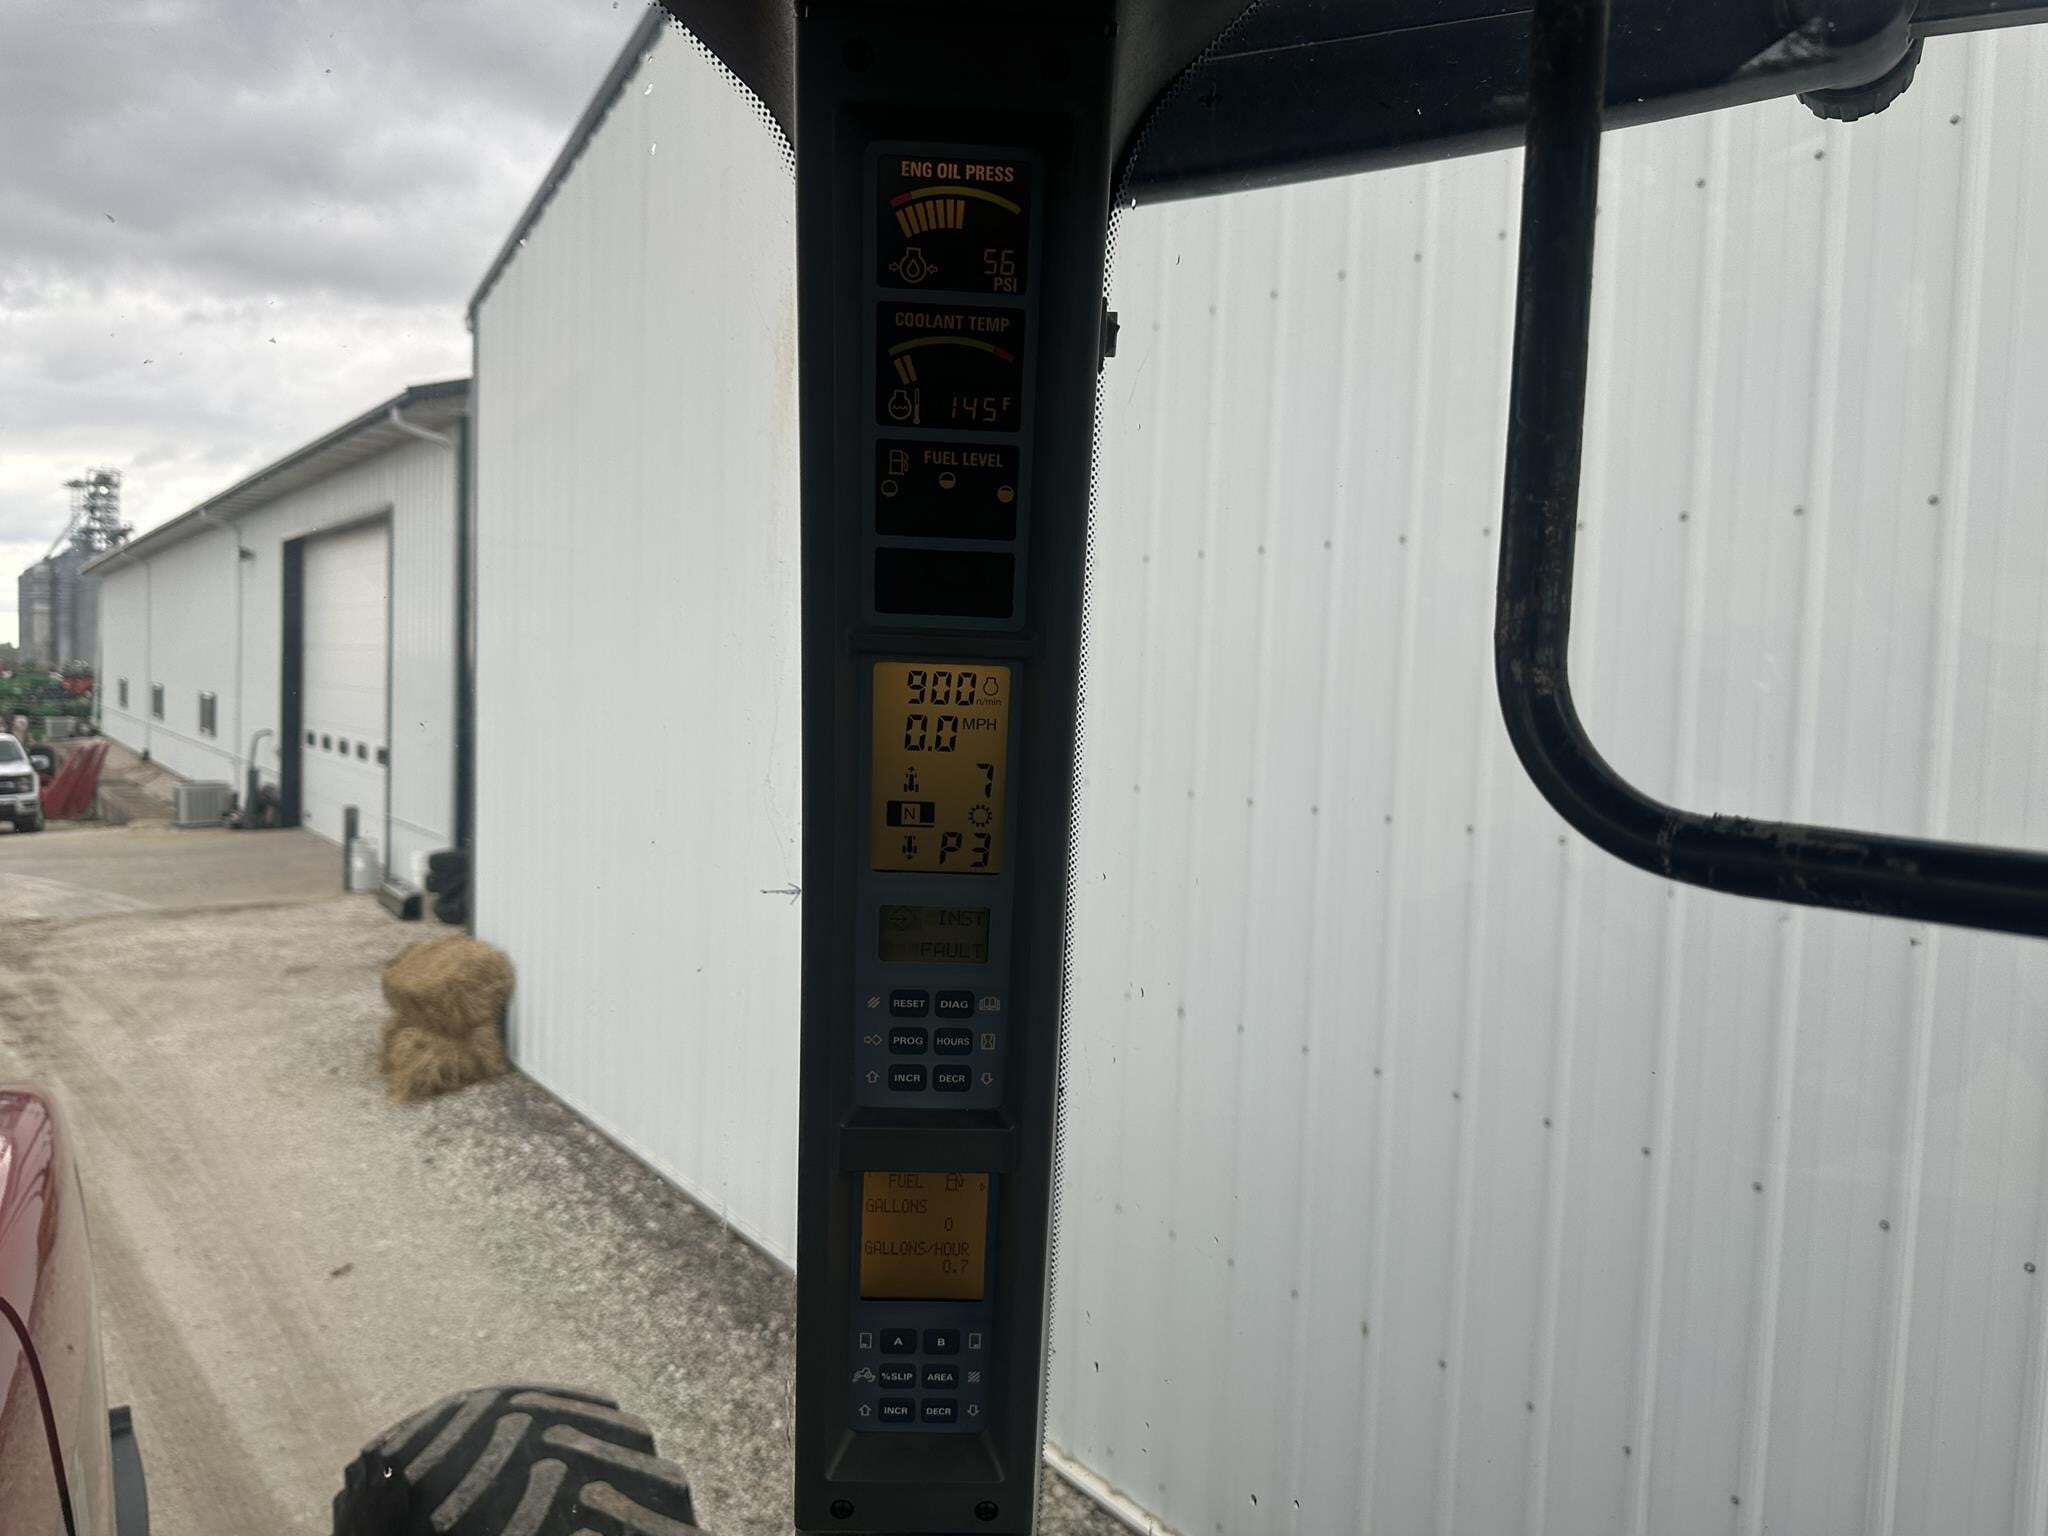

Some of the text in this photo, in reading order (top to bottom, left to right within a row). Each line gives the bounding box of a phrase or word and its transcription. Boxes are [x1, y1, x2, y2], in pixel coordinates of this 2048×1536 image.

[900, 160, 1015, 182] ENG OIL PRESS
[982, 248, 1016, 276] 56
[993, 277, 1018, 293] PSI
[895, 311, 1010, 333] COOLANT TEMP
[951, 397, 998, 423] 145
[923, 450, 1004, 468] FUEL LEVEL
[907, 670, 977, 705] 900
[904, 714, 998, 752] 0.0 MPH
[976, 762, 995, 798] 7
[903, 806, 917, 821] N
[938, 909, 986, 927] INST
[892, 998, 926, 1009] RESET
[939, 999, 970, 1010] DIAG
[892, 1035, 924, 1046] PROG
[936, 1036, 971, 1047] HOURS
[893, 1072, 922, 1083] INCR
[938, 1073, 966, 1084] DECR
[887, 1173, 925, 1189] FUEL
[865, 1198, 929, 1214] GALLONS
[943, 1216, 954, 1232] 0
[864, 1240, 971, 1257] GALLONS/HOUR
[941, 1259, 970, 1274] 0.7
[892, 1336, 904, 1347] A
[936, 1336, 947, 1347] B
[880, 1371, 914, 1382] %SLIP
[926, 1372, 954, 1382] AREA
[882, 1405, 909, 1416] INCR
[925, 1406, 952, 1416] DECR
